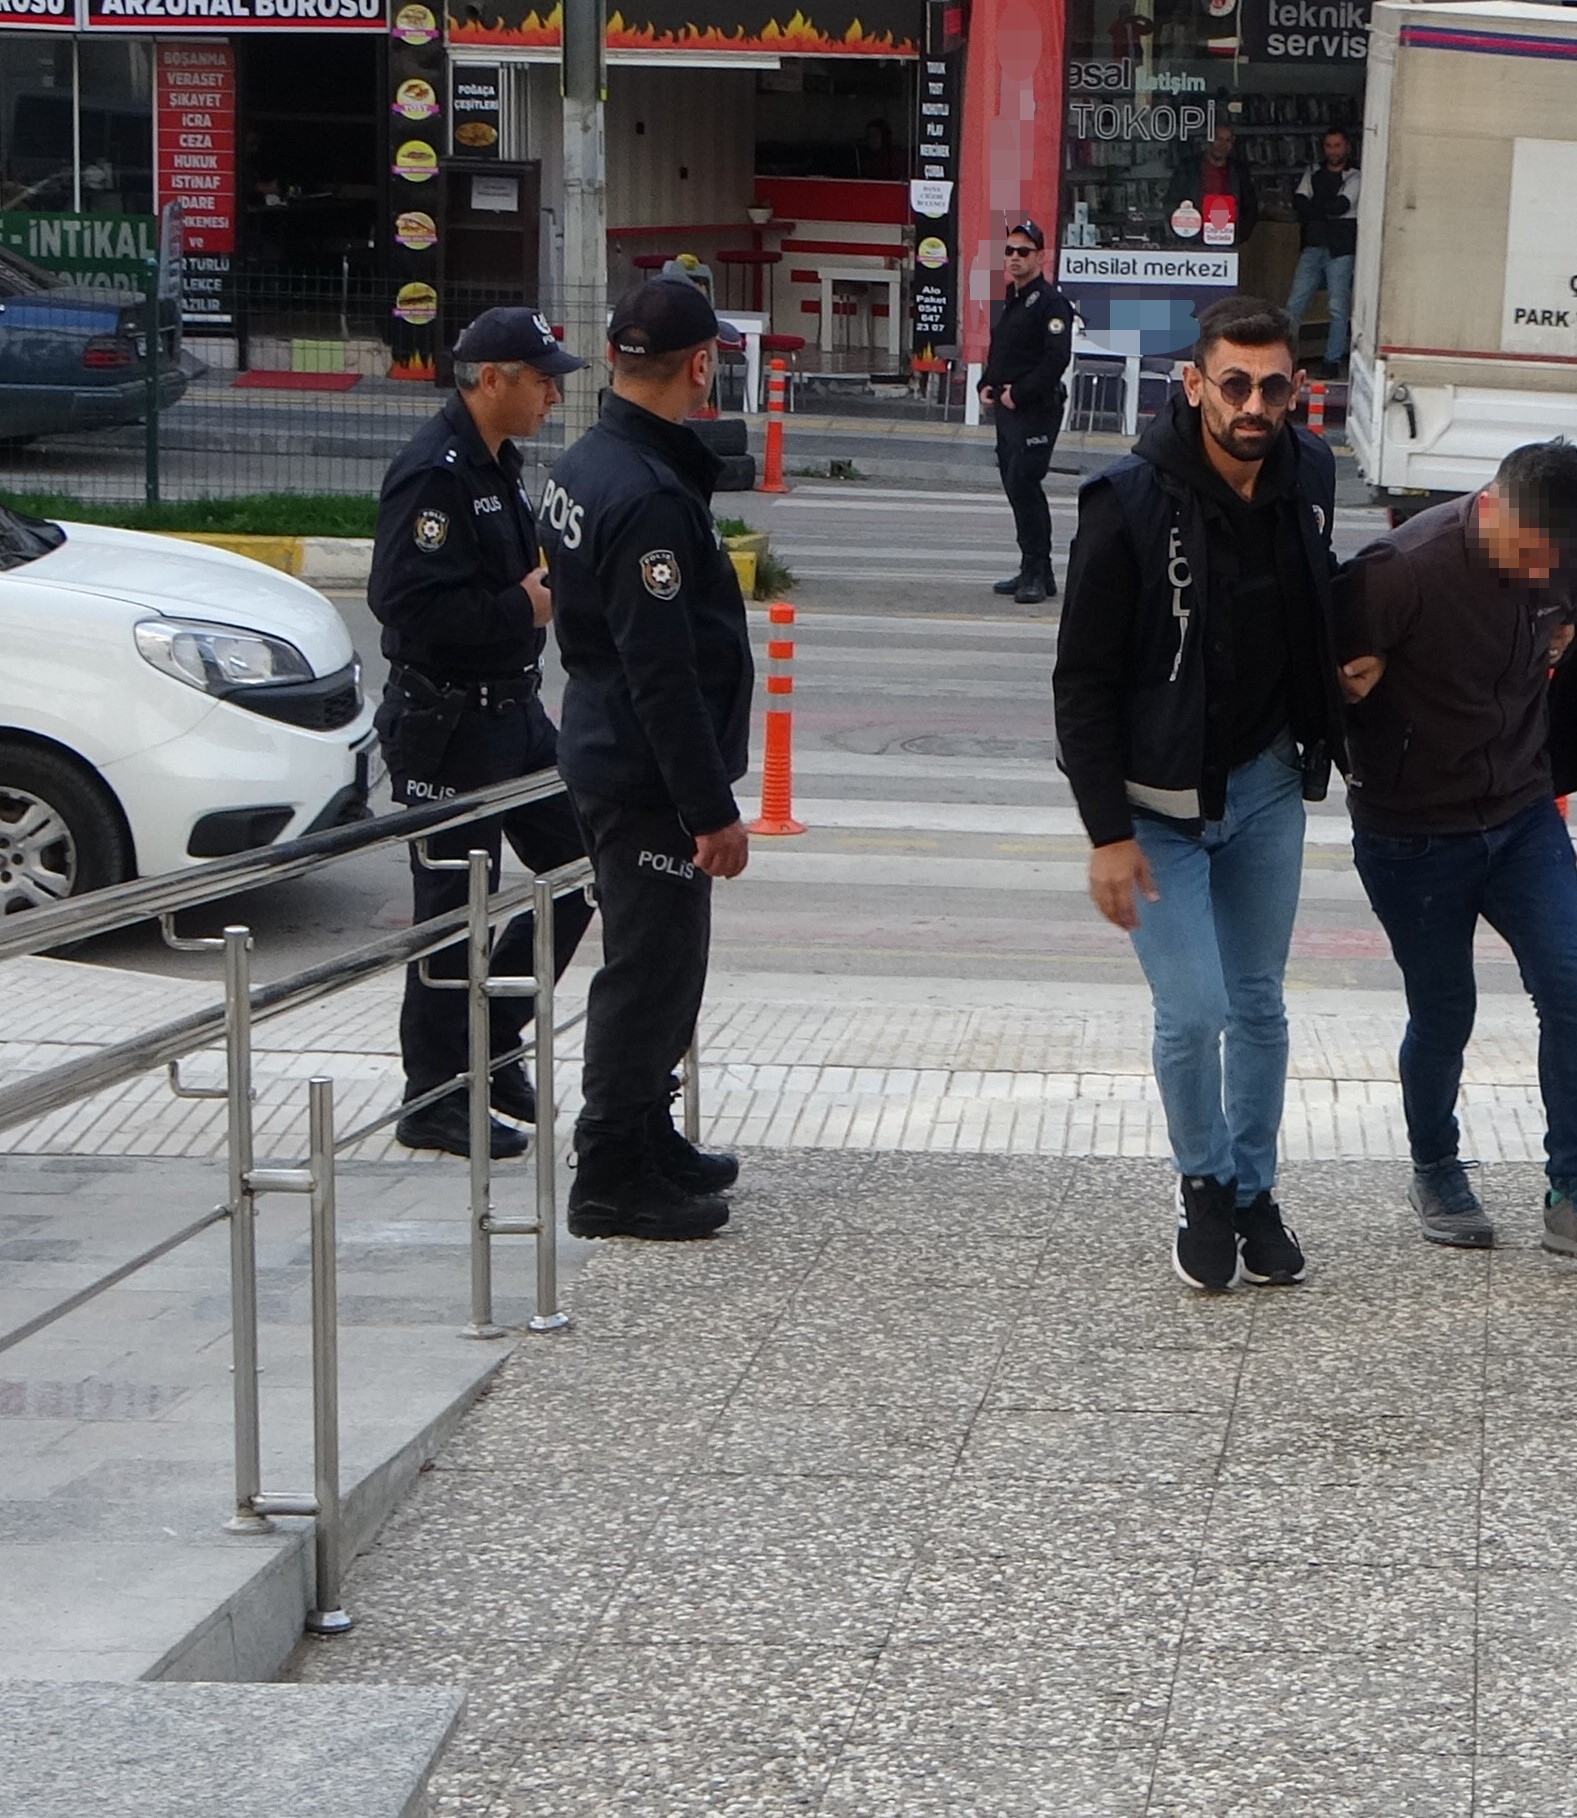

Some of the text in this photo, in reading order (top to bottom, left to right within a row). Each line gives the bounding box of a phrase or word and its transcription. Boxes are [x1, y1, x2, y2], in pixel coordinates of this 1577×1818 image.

[1268, 1, 1366, 29] teknik
[1266, 31, 1367, 59] servis
[163, 51, 226, 67] BOŞANMA
[166, 72, 224, 87] VERASET
[179, 133, 213, 148] CEZA
[173, 154, 218, 169] HUKUK
[1066, 257, 1228, 277] tahsilat merkezi
[1515, 308, 1569, 328] PARK
